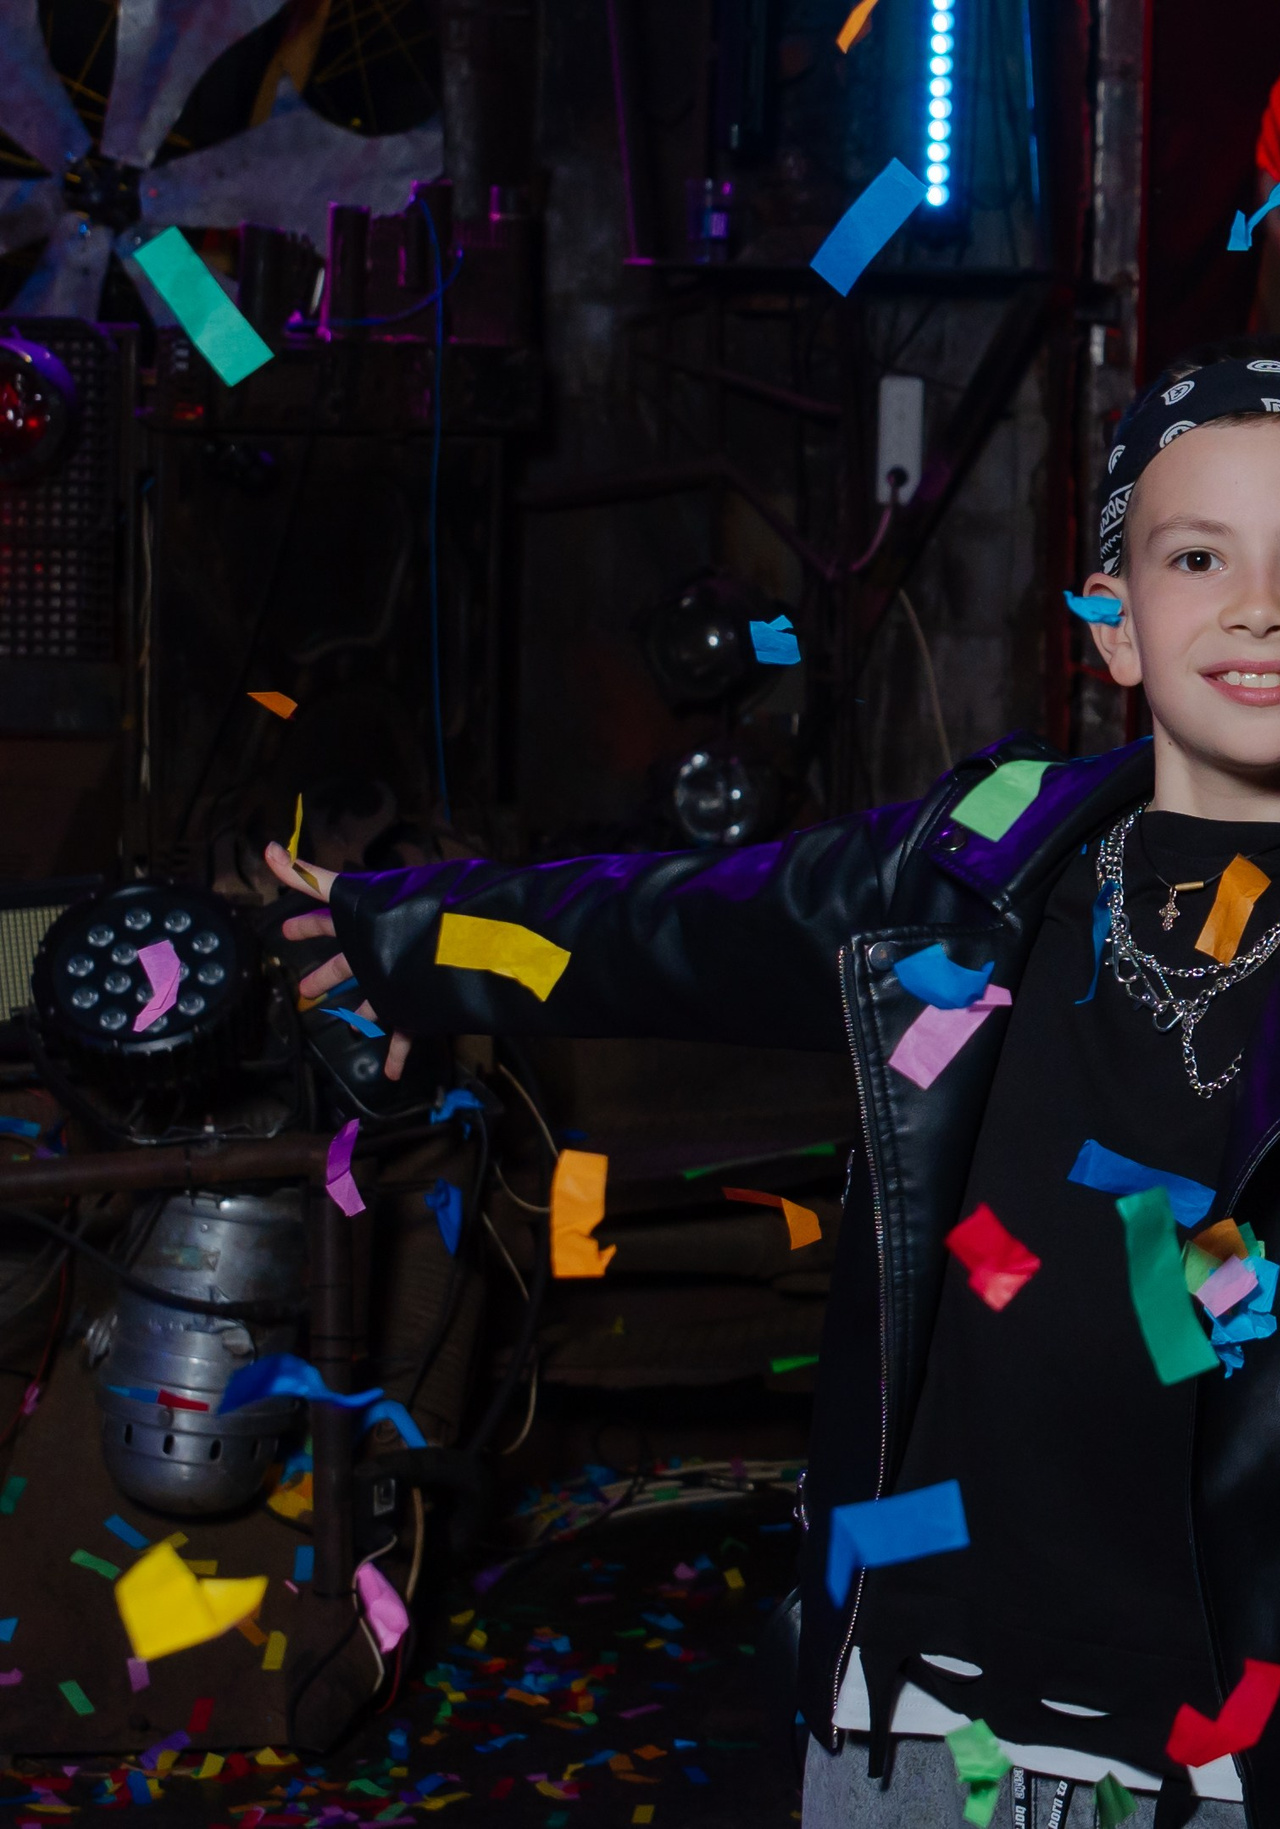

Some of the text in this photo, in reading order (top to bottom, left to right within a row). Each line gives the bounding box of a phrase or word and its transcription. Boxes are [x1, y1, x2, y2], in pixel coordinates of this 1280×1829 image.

[1015, 1805, 1027, 1829] bor
[1048, 1780, 1068, 1829] born to
